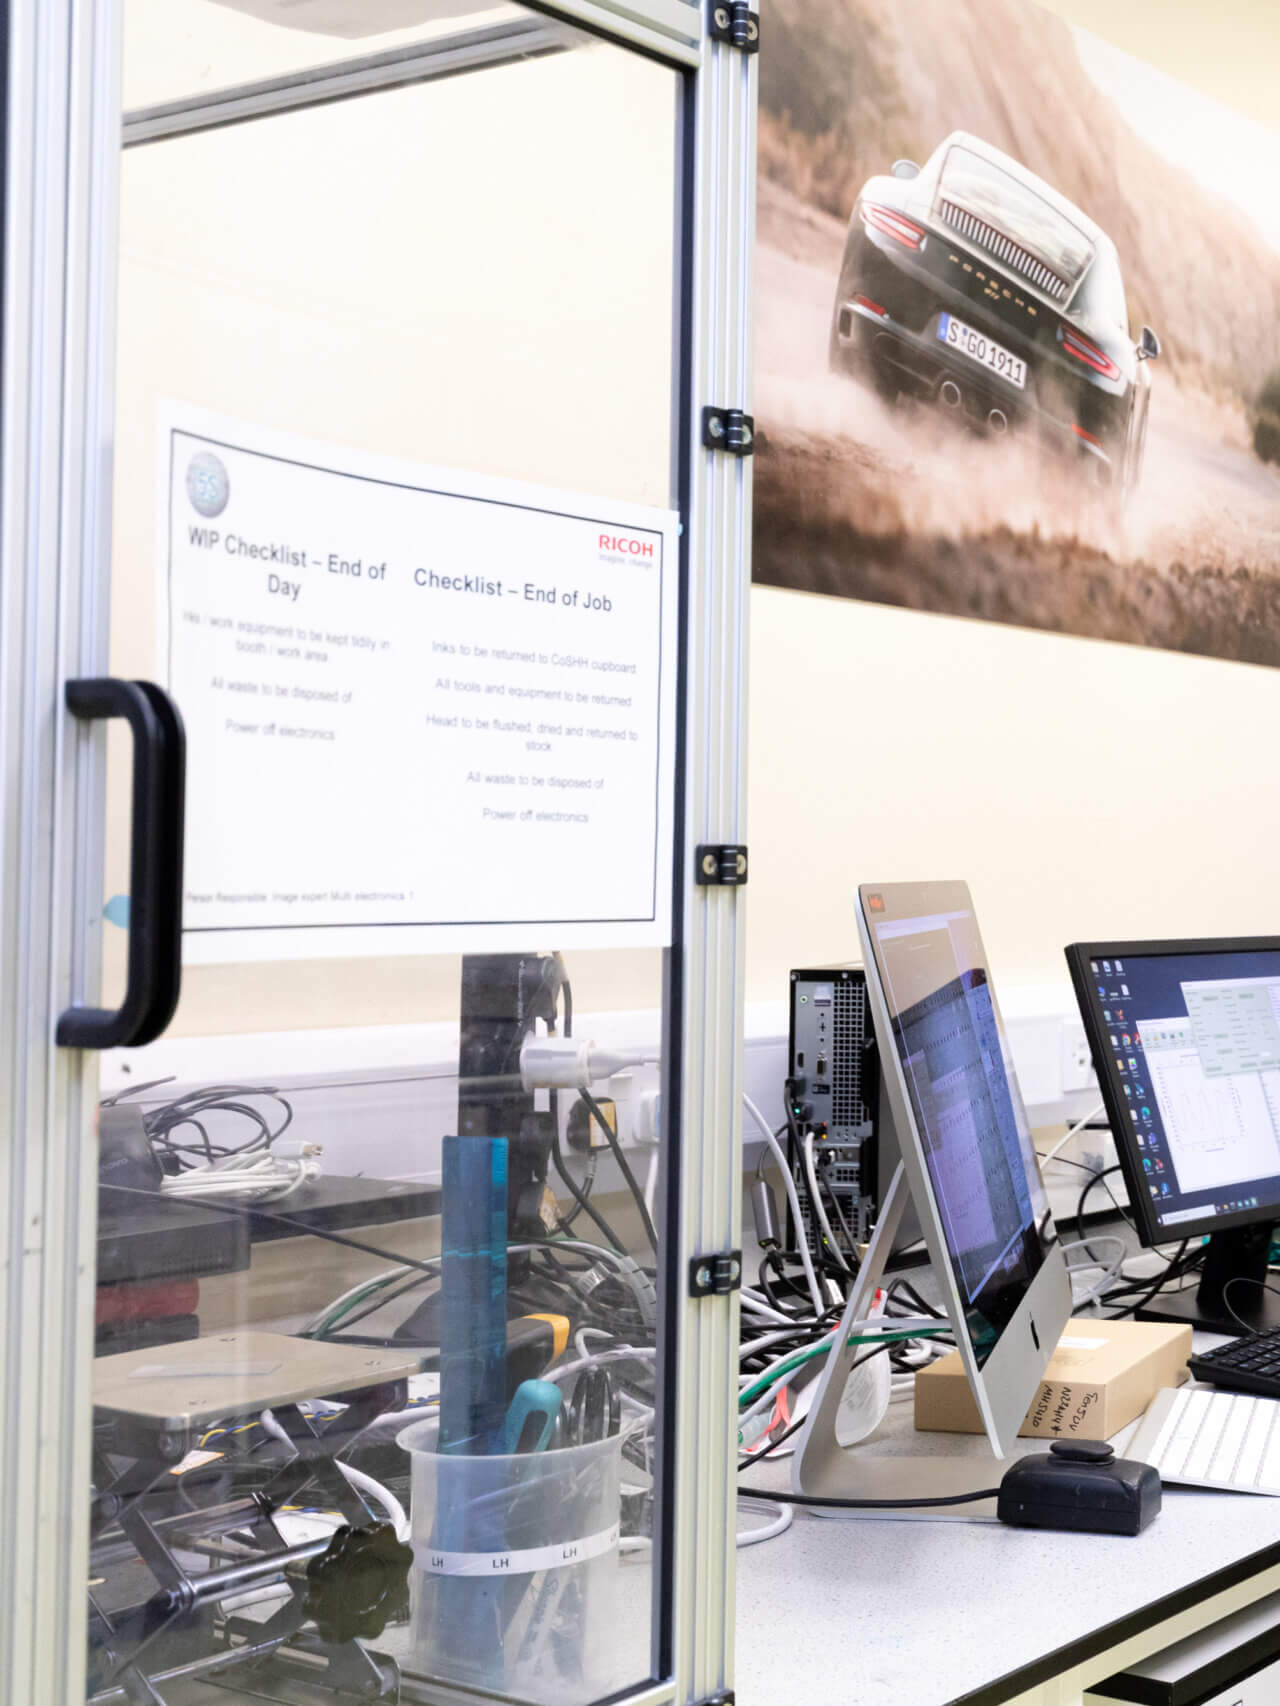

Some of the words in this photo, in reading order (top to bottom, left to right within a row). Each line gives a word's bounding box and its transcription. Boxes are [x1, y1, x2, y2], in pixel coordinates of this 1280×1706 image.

[189, 525, 219, 549] WIP
[225, 534, 307, 568] Checklist
[328, 553, 361, 578] End
[368, 562, 387, 580] of
[598, 534, 654, 558] RICOH
[268, 573, 301, 602] Day
[414, 568, 503, 597] Checklist
[524, 583, 557, 604] End
[562, 590, 579, 607] of
[583, 594, 613, 612] Job
[237, 619, 294, 637] equipment
[297, 628, 307, 641] to
[310, 629, 323, 642] be
[326, 631, 349, 648] kept
[304, 651, 328, 663] area
[459, 643, 471, 656] to
[474, 645, 488, 659] be
[491, 646, 536, 663] returned
[538, 652, 549, 665] to
[591, 659, 638, 675] cupboard
[211, 675, 224, 690] All
[227, 680, 258, 695] waste
[262, 683, 272, 696] to
[275, 684, 289, 698] be
[291, 686, 339, 704] disposed
[342, 690, 353, 704] of
[435, 676, 451, 690] All
[453, 679, 481, 694] tools
[485, 682, 505, 697] and
[508, 684, 562, 701] equipment
[564, 689, 574, 703] to
[576, 691, 589, 704] be
[591, 693, 633, 708] returned
[225, 718, 259, 734] Power
[279, 724, 336, 741] electronics
[426, 713, 458, 728] Head
[461, 715, 472, 729] to
[475, 717, 490, 730] be
[536, 721, 562, 736] dried
[564, 724, 583, 738] and
[586, 725, 627, 741] returned
[628, 729, 639, 742] to
[525, 739, 552, 752] stock
[466, 770, 481, 783] All
[485, 773, 516, 786] waste
[518, 774, 529, 787] to
[531, 775, 545, 787] be
[547, 776, 592, 790] disposed
[594, 777, 605, 790] of
[482, 807, 517, 821] Power
[519, 808, 533, 822] off
[535, 810, 589, 823] electronics
[431, 1556, 444, 1569] LH
[492, 1557, 510, 1569] LH
[562, 1546, 578, 1559] LH
